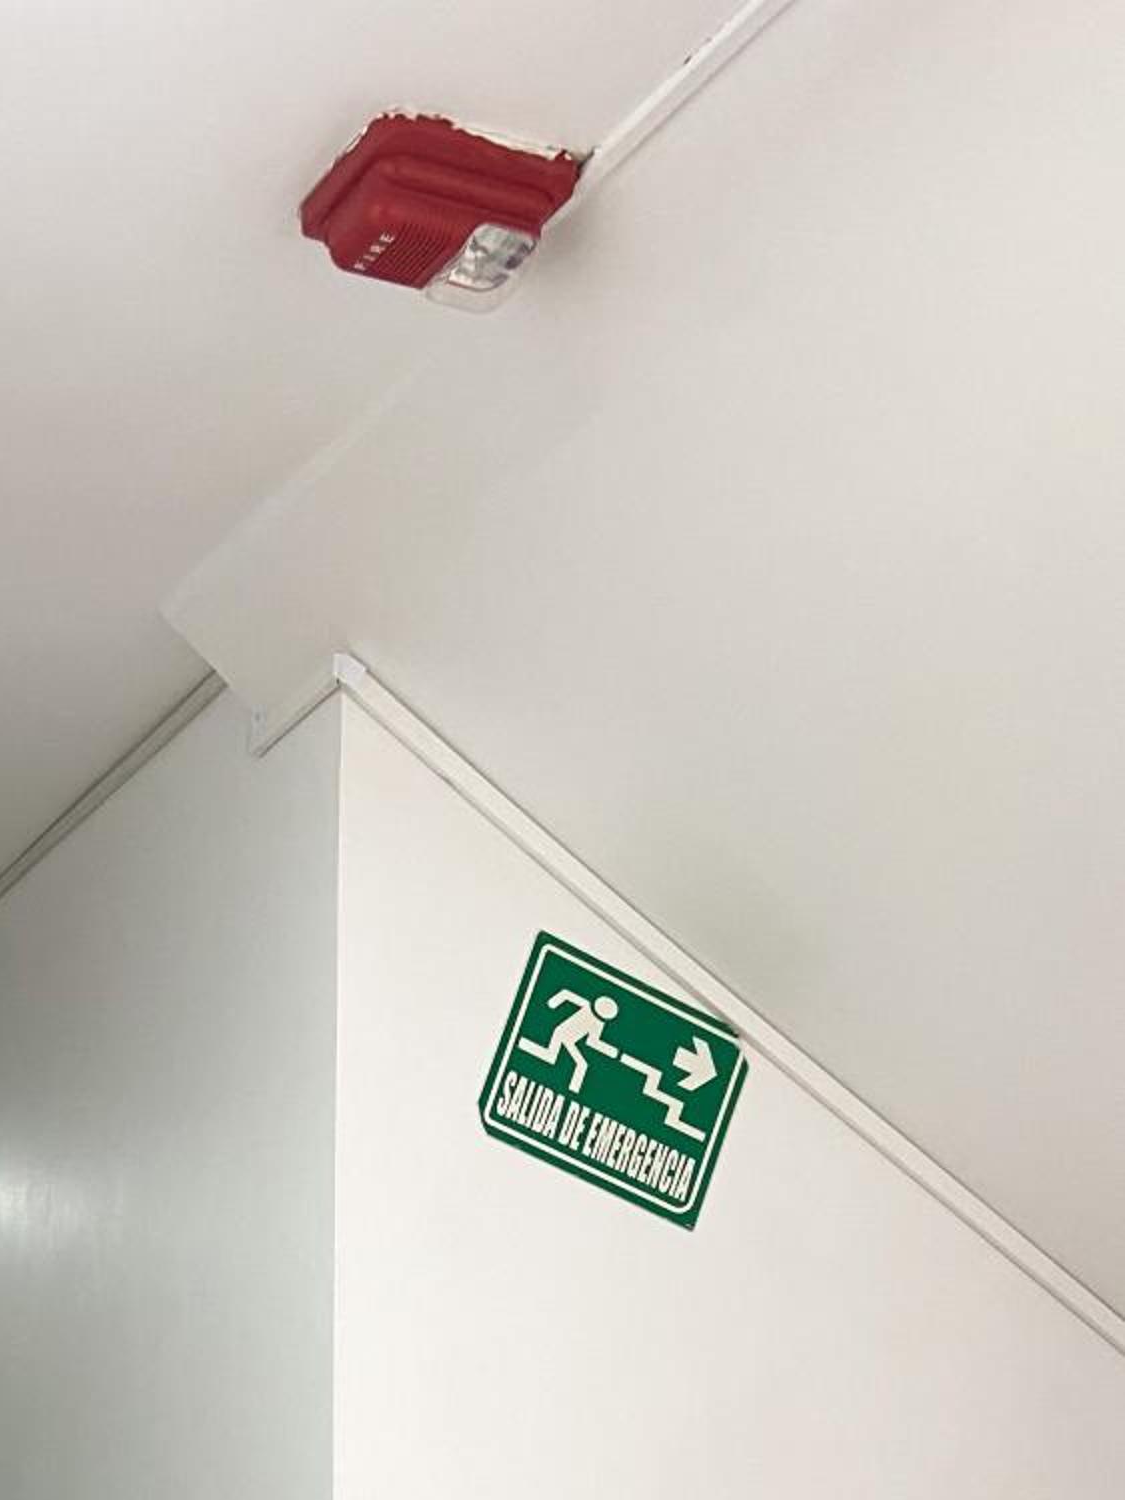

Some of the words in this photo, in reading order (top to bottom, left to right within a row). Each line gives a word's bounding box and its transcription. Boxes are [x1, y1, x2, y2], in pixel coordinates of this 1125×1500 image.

[495, 1070, 566, 1139] SALIDA
[558, 1100, 592, 1151] DE
[581, 1112, 696, 1201] EMERGENCIA
